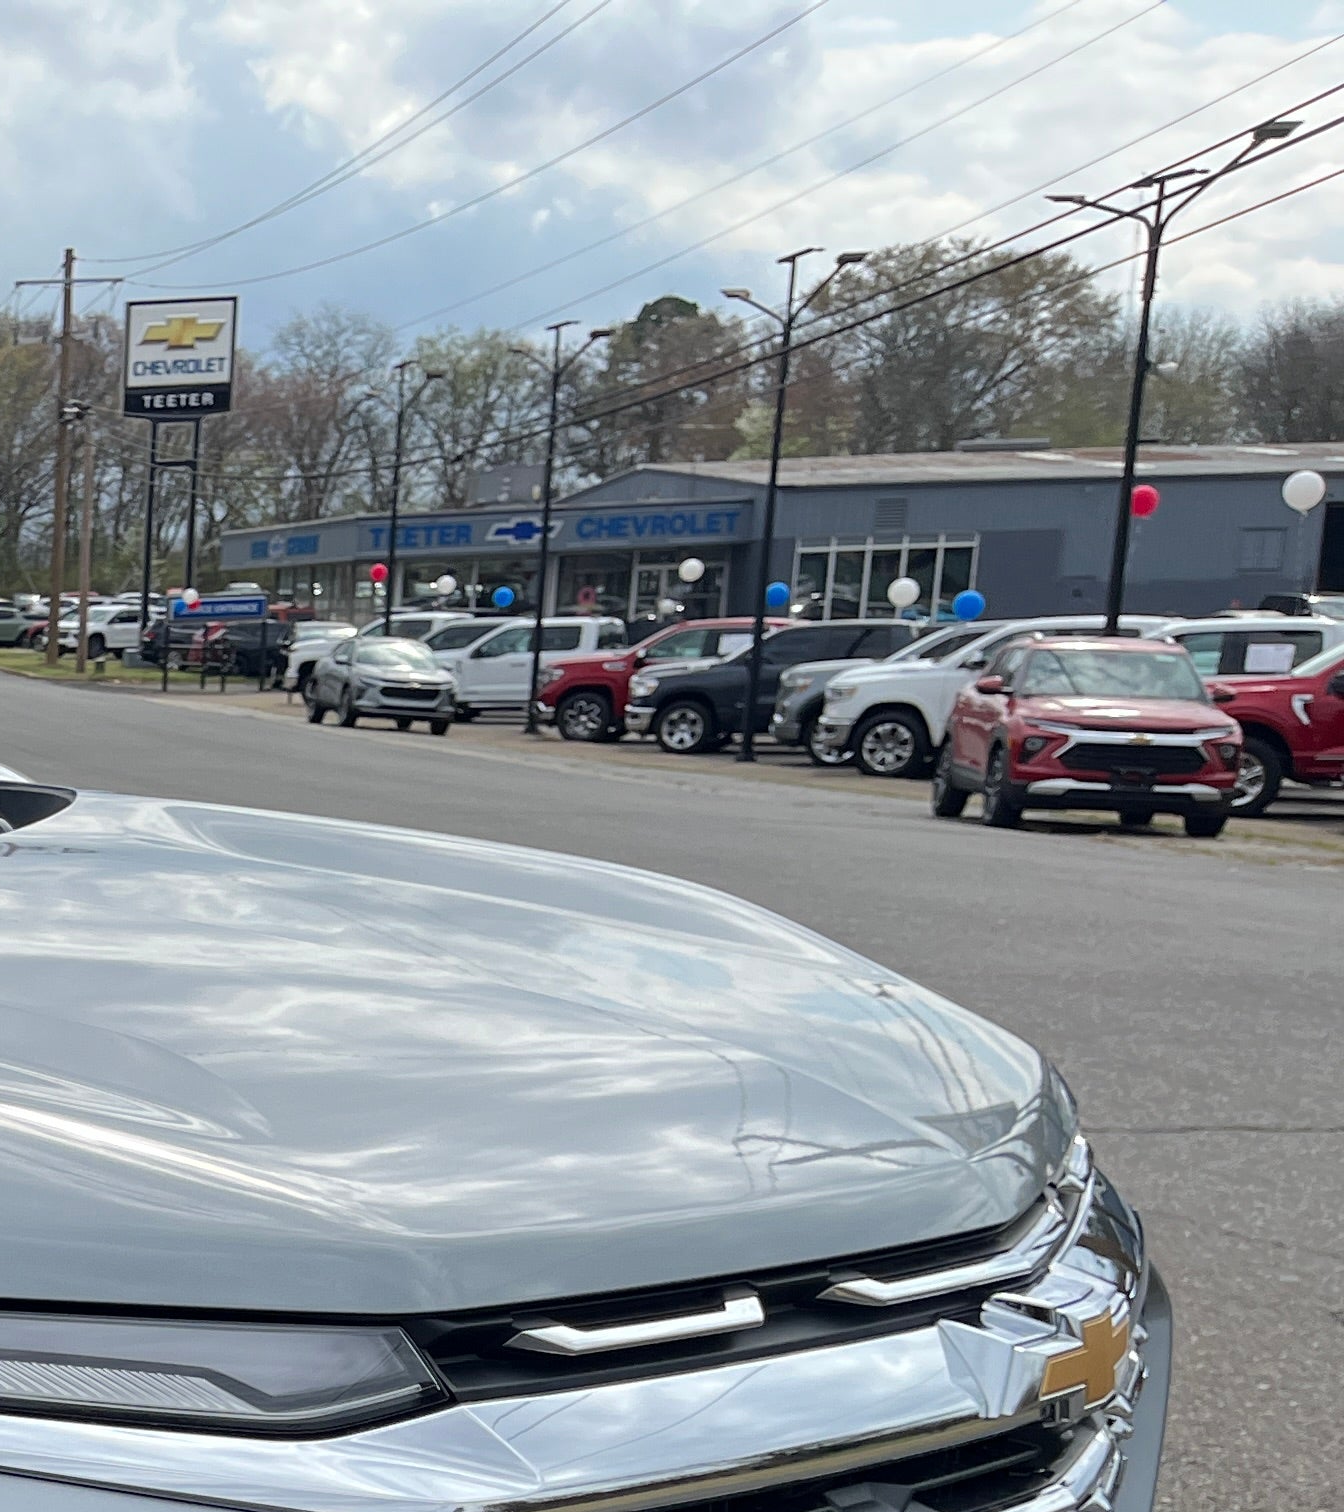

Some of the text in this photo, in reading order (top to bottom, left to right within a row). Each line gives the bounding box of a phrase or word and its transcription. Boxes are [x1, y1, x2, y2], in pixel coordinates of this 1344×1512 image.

[132, 356, 226, 377] CHEVROLET
[142, 392, 215, 409] TEETER
[370, 524, 472, 549] TEETER
[576, 512, 740, 539] CHEVROLET
